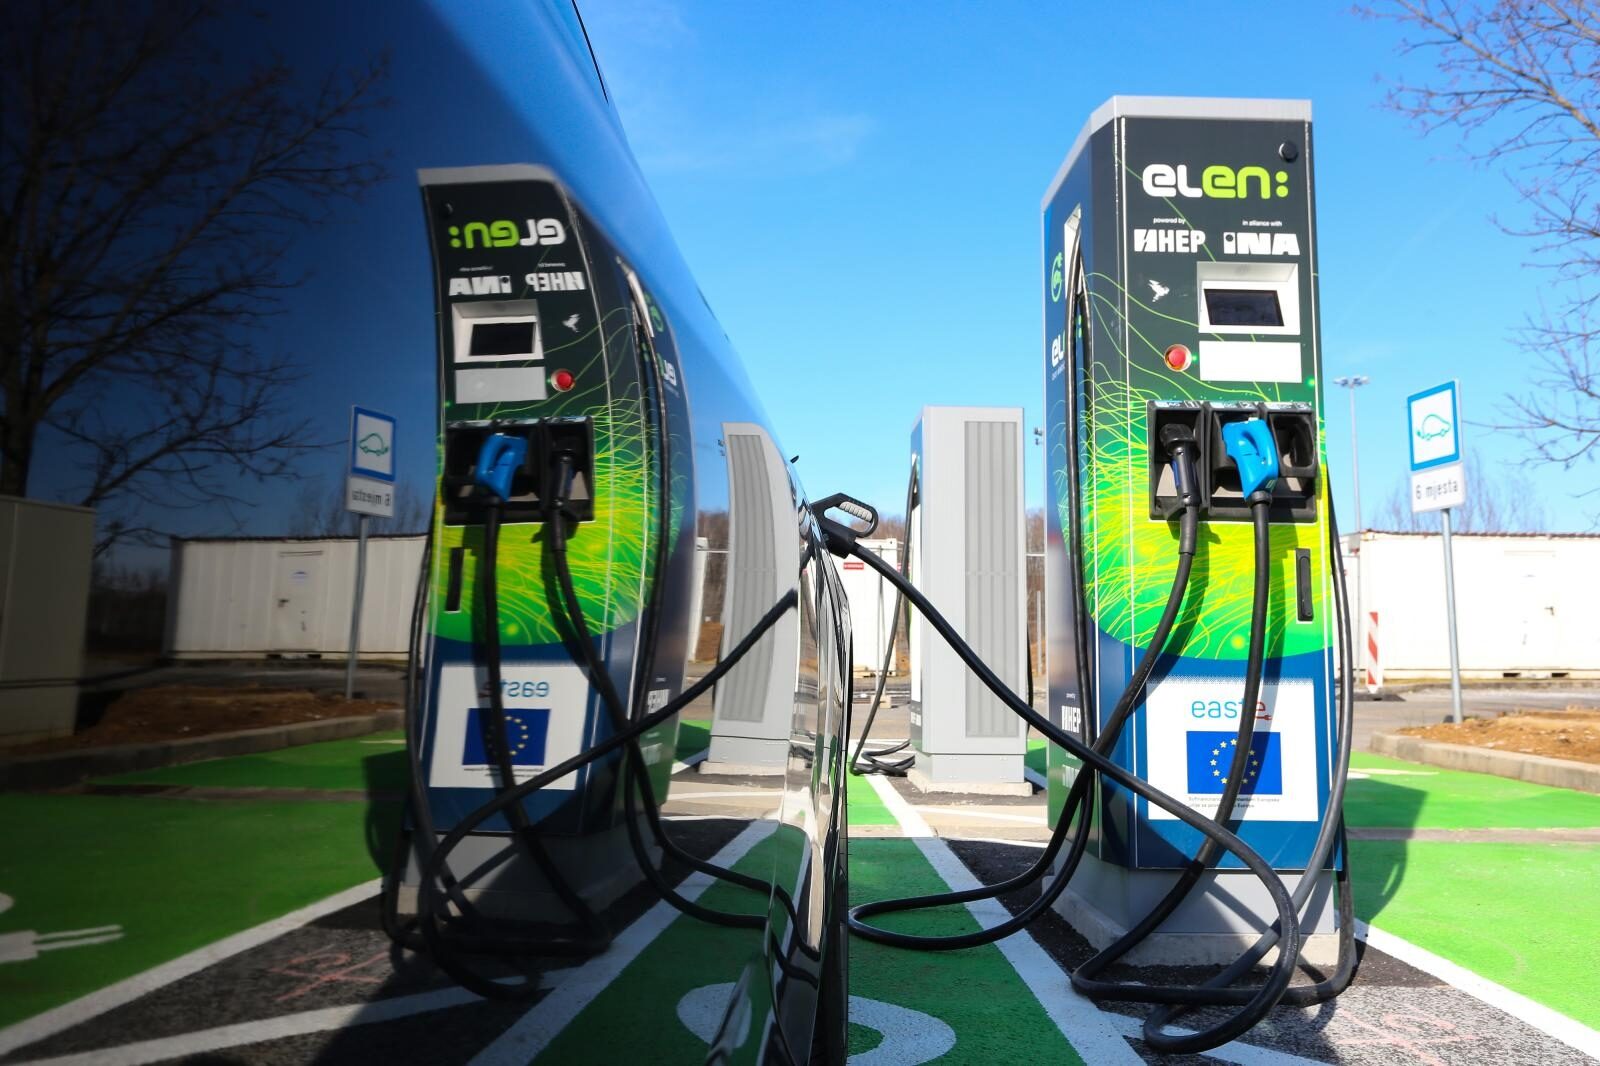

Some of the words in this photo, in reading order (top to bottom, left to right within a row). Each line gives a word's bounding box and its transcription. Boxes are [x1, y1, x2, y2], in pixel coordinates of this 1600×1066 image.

[1178, 217, 1185, 225] by
[1416, 484, 1421, 500] 6
[1425, 478, 1458, 500] mjesta
